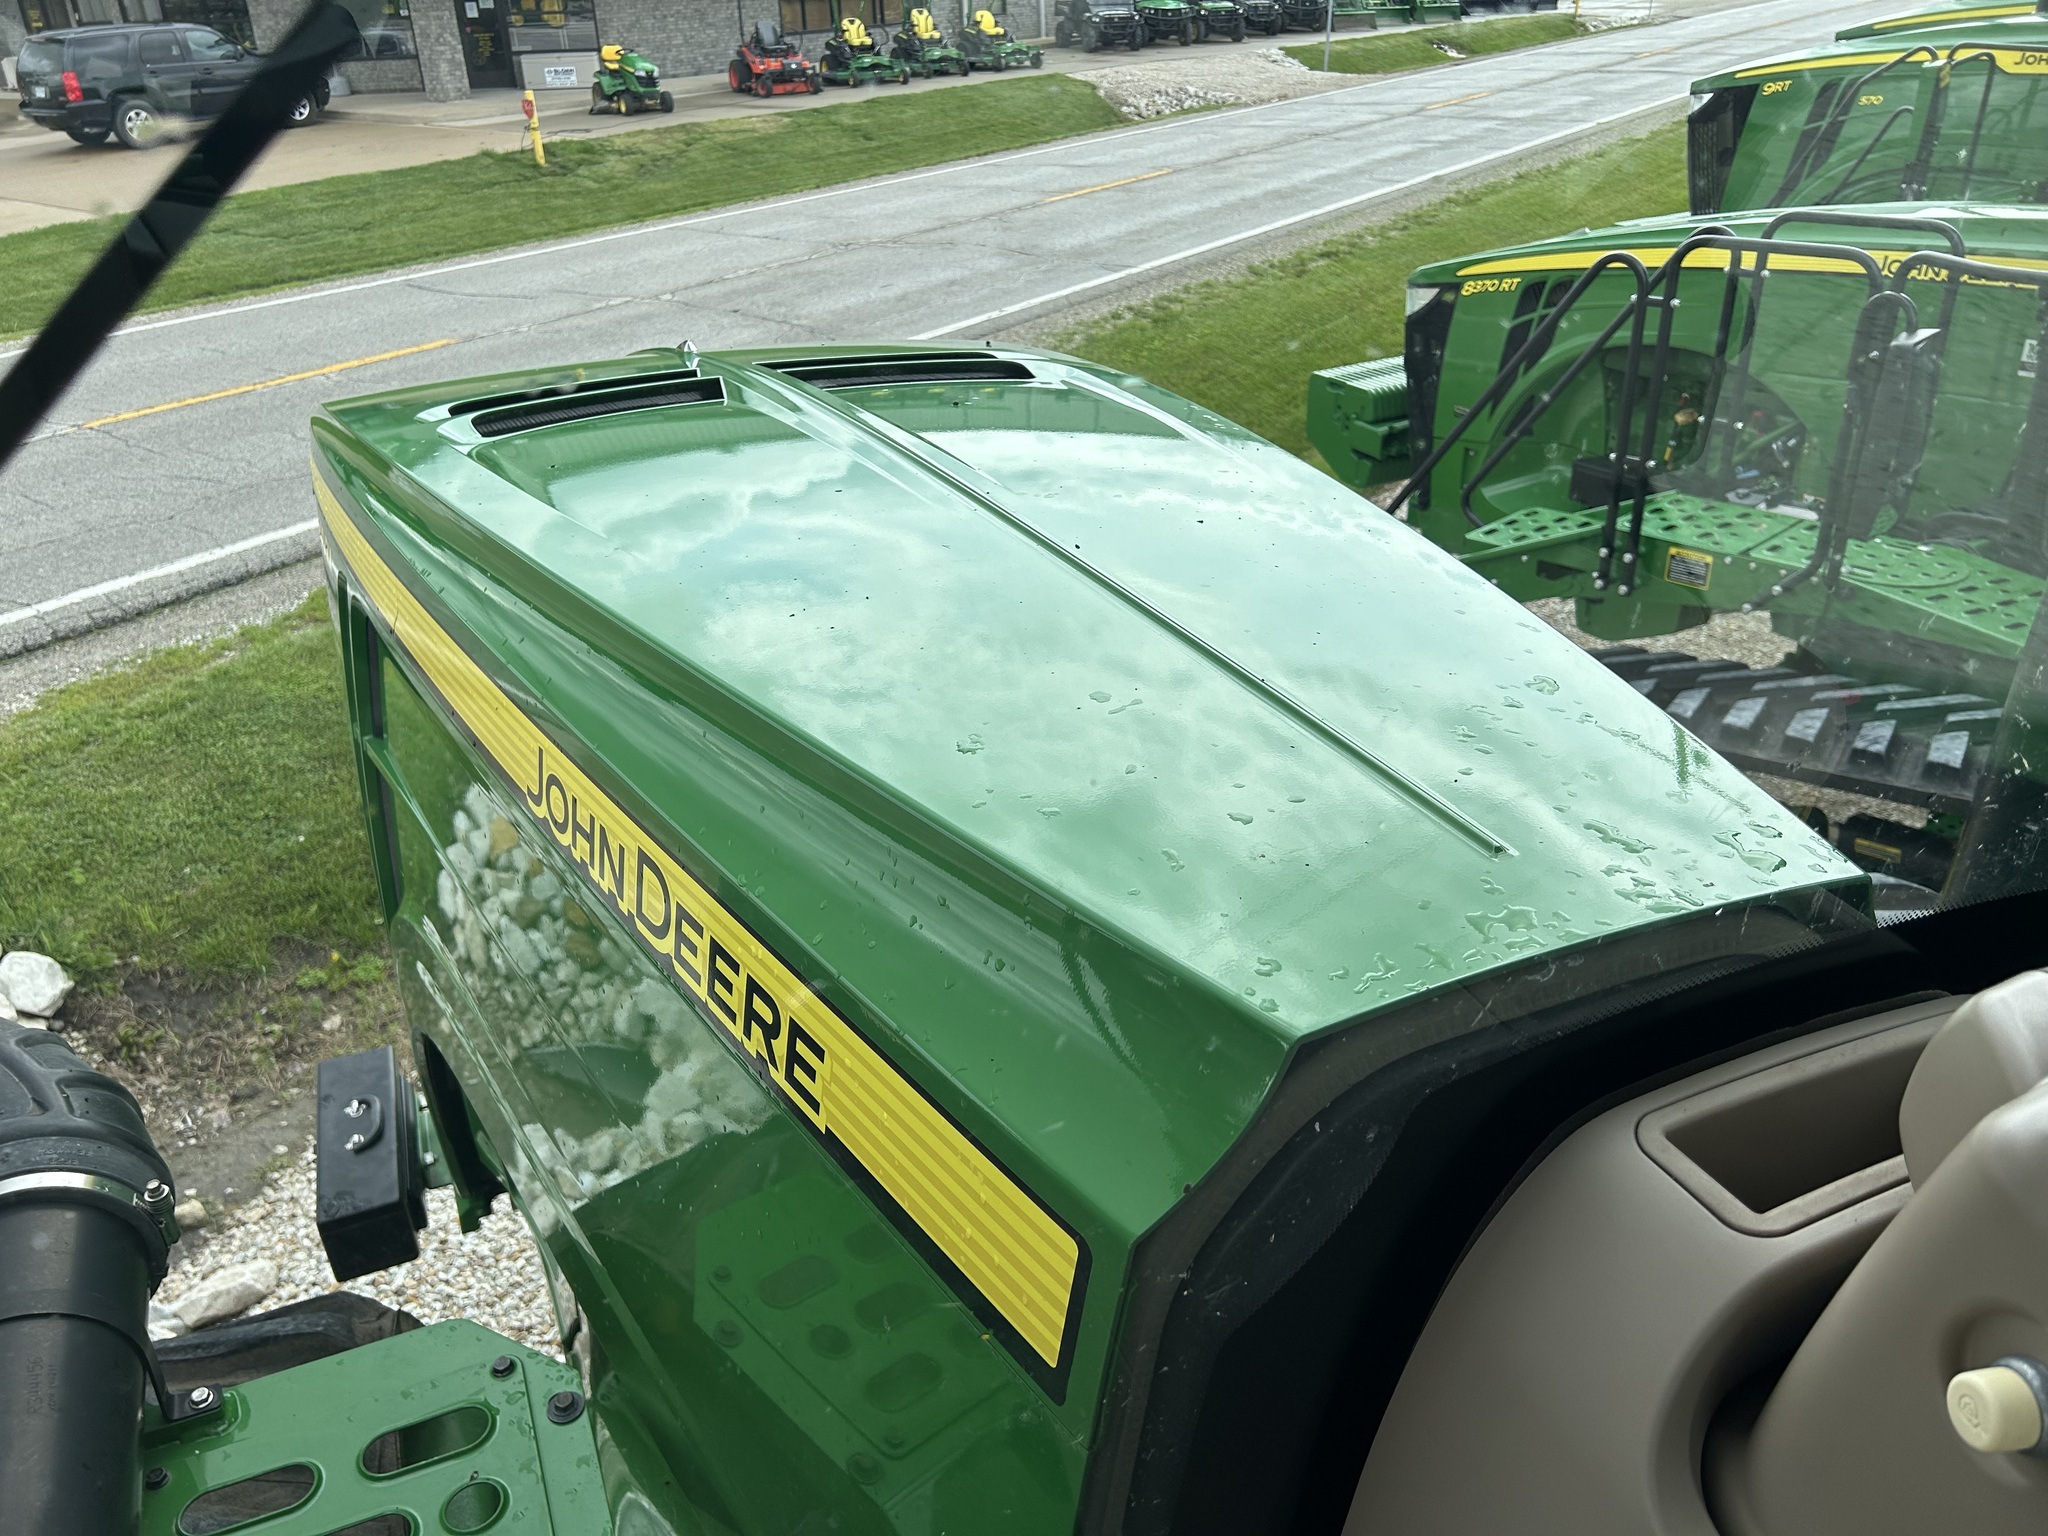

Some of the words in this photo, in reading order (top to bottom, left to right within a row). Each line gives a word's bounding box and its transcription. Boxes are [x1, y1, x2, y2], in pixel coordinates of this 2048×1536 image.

[1761, 80, 1793, 96] 9RT
[1857, 95, 1884, 106] 570
[1460, 279, 1500, 296] 8370
[1499, 277, 1523, 292] RT
[526, 746, 626, 902] JOHN
[635, 844, 827, 1117] DEERE
